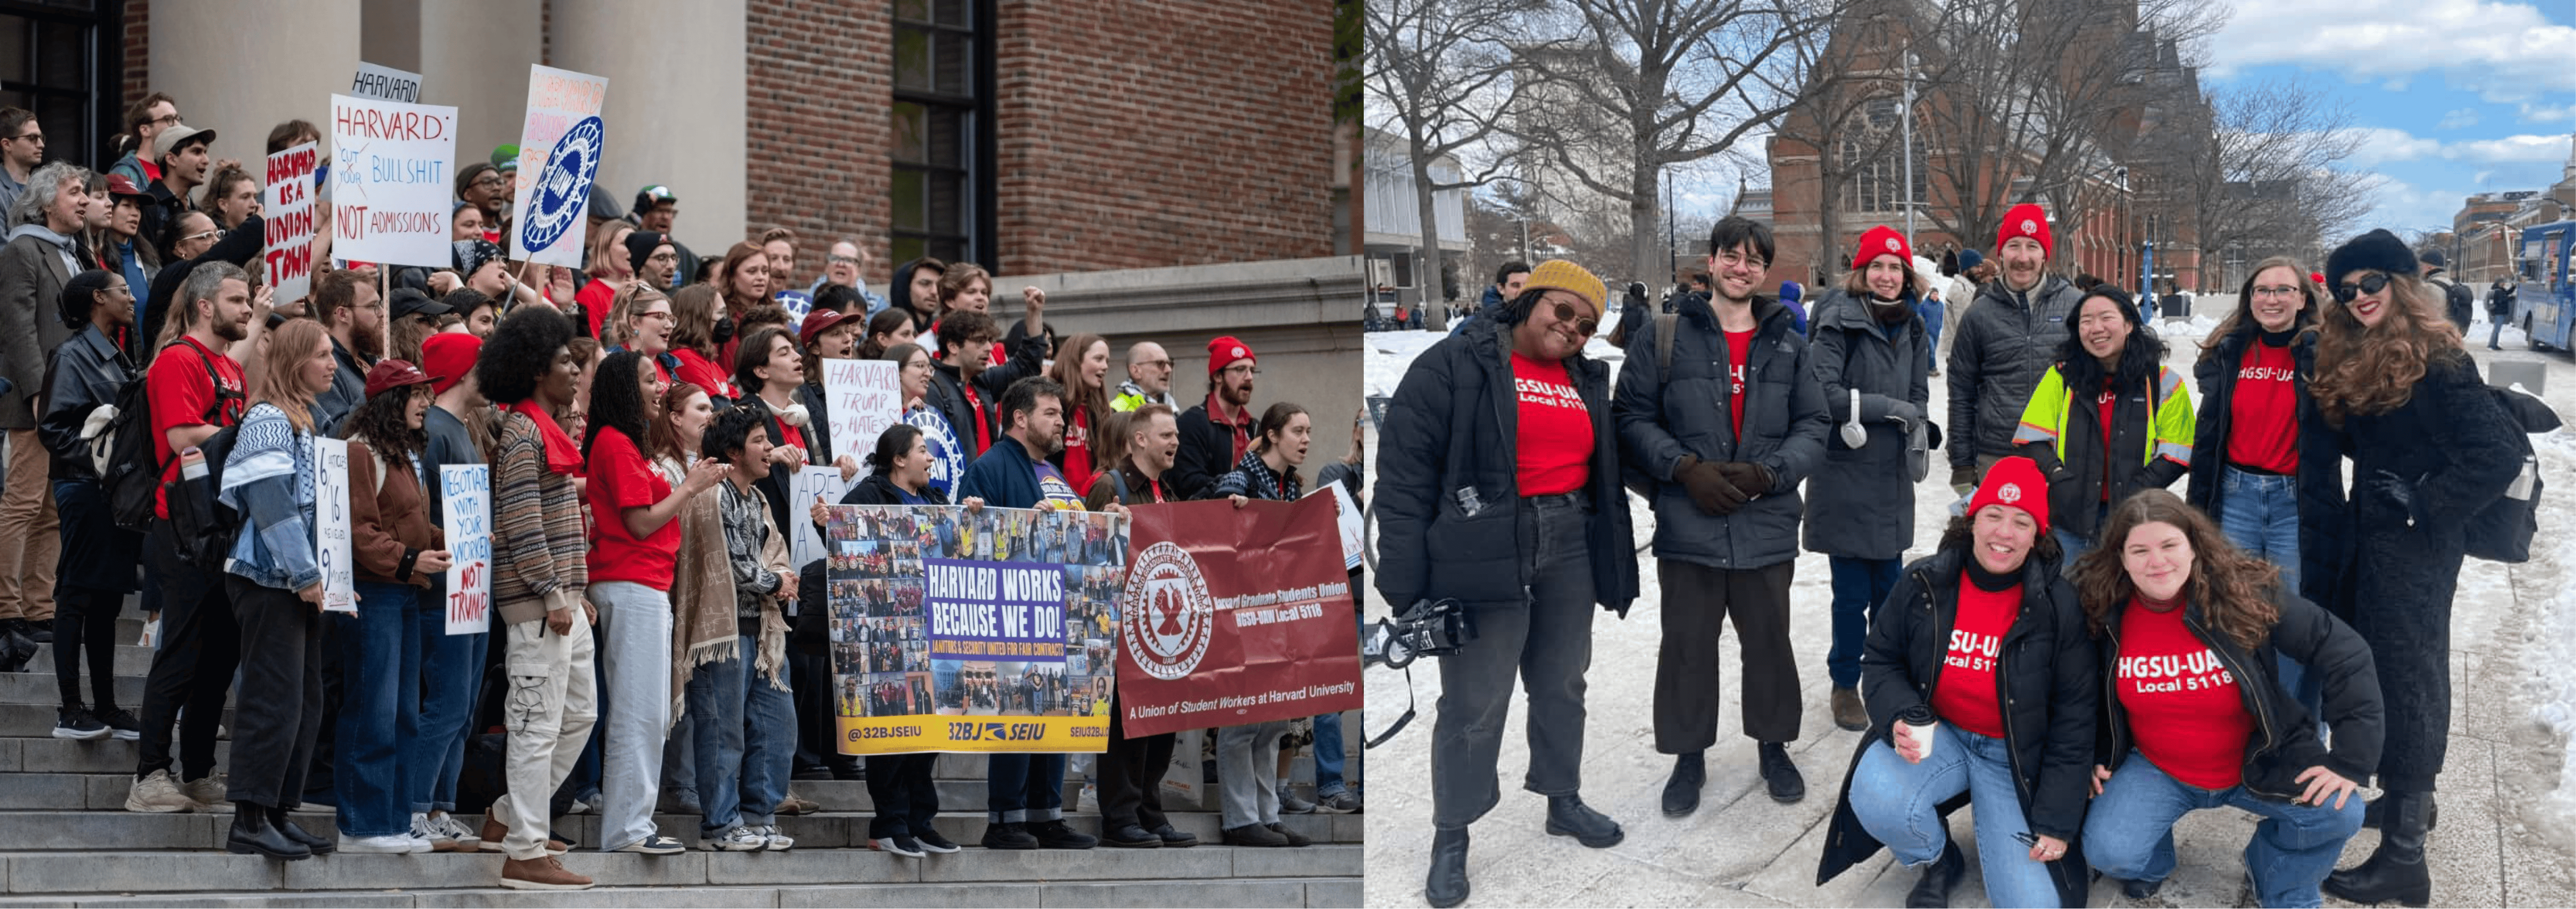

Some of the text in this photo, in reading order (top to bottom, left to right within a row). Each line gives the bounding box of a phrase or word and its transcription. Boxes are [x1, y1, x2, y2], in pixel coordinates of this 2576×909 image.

[352, 71, 417, 103] HARVARD
[338, 105, 449, 142] HARVARD:
[267, 148, 316, 187] HARVARD
[338, 155, 443, 184] YOUR BULLSHIT
[549, 164, 575, 199] UAW
[280, 180, 304, 205] IS A
[266, 203, 312, 247] UNION
[338, 204, 440, 240] NOT ADMISSIONS
[266, 240, 312, 288] TOWN
[2238, 366, 2294, 382] HGSU-UA
[842, 393, 888, 413] TRUMP
[1515, 378, 1581, 401] GSU-UA
[1519, 392, 1557, 407] Local
[848, 416, 887, 434] HATES
[927, 456, 948, 481] AW
[457, 515, 482, 538] YOUR
[322, 548, 330, 591] 9
[462, 562, 484, 590] NOT
[928, 565, 1061, 602] HARVARD WORKS
[1132, 576, 1146, 619] HARVARD
[1143, 555, 1171, 576] GRADUATE
[1241, 592, 1276, 608] Graduate
[1276, 586, 1317, 603] Students
[1318, 582, 1348, 597] Union
[449, 591, 488, 624] TRUMP
[933, 602, 1061, 638] BECAUSE WE DO!
[1235, 603, 1323, 628] HGSU-UAW Local 5118
[932, 639, 957, 654] JANITORS
[963, 641, 986, 655] SECURITY
[987, 641, 1006, 656] UNITED
[1007, 642, 1018, 656] FOR
[1019, 642, 1032, 656] FAIR
[1033, 642, 1064, 656] CONTRACTS
[1162, 656, 1176, 664] UAW
[2118, 649, 2223, 678] HGSU-UA
[2137, 670, 2233, 693] Local 5118
[1129, 680, 1355, 720] A Union of Student Workers at Harvard University
[848, 725, 921, 742] @32BJSEIU
[949, 722, 1046, 741] 32BJ SEIU
